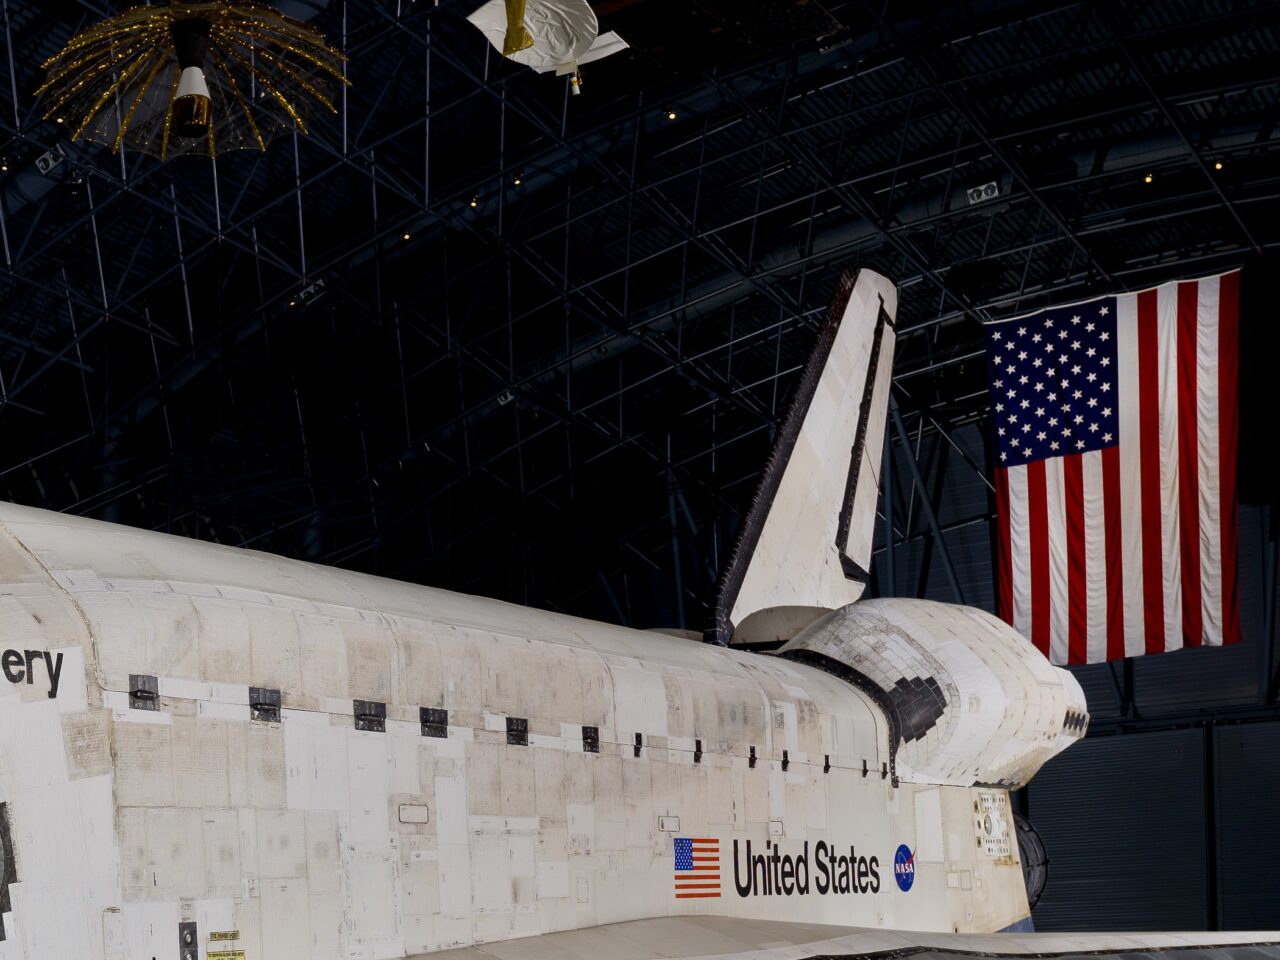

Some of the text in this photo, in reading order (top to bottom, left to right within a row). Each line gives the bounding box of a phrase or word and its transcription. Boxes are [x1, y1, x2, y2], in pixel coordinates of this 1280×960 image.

[733, 839, 880, 898] United States
[895, 862, 914, 874] NASA
